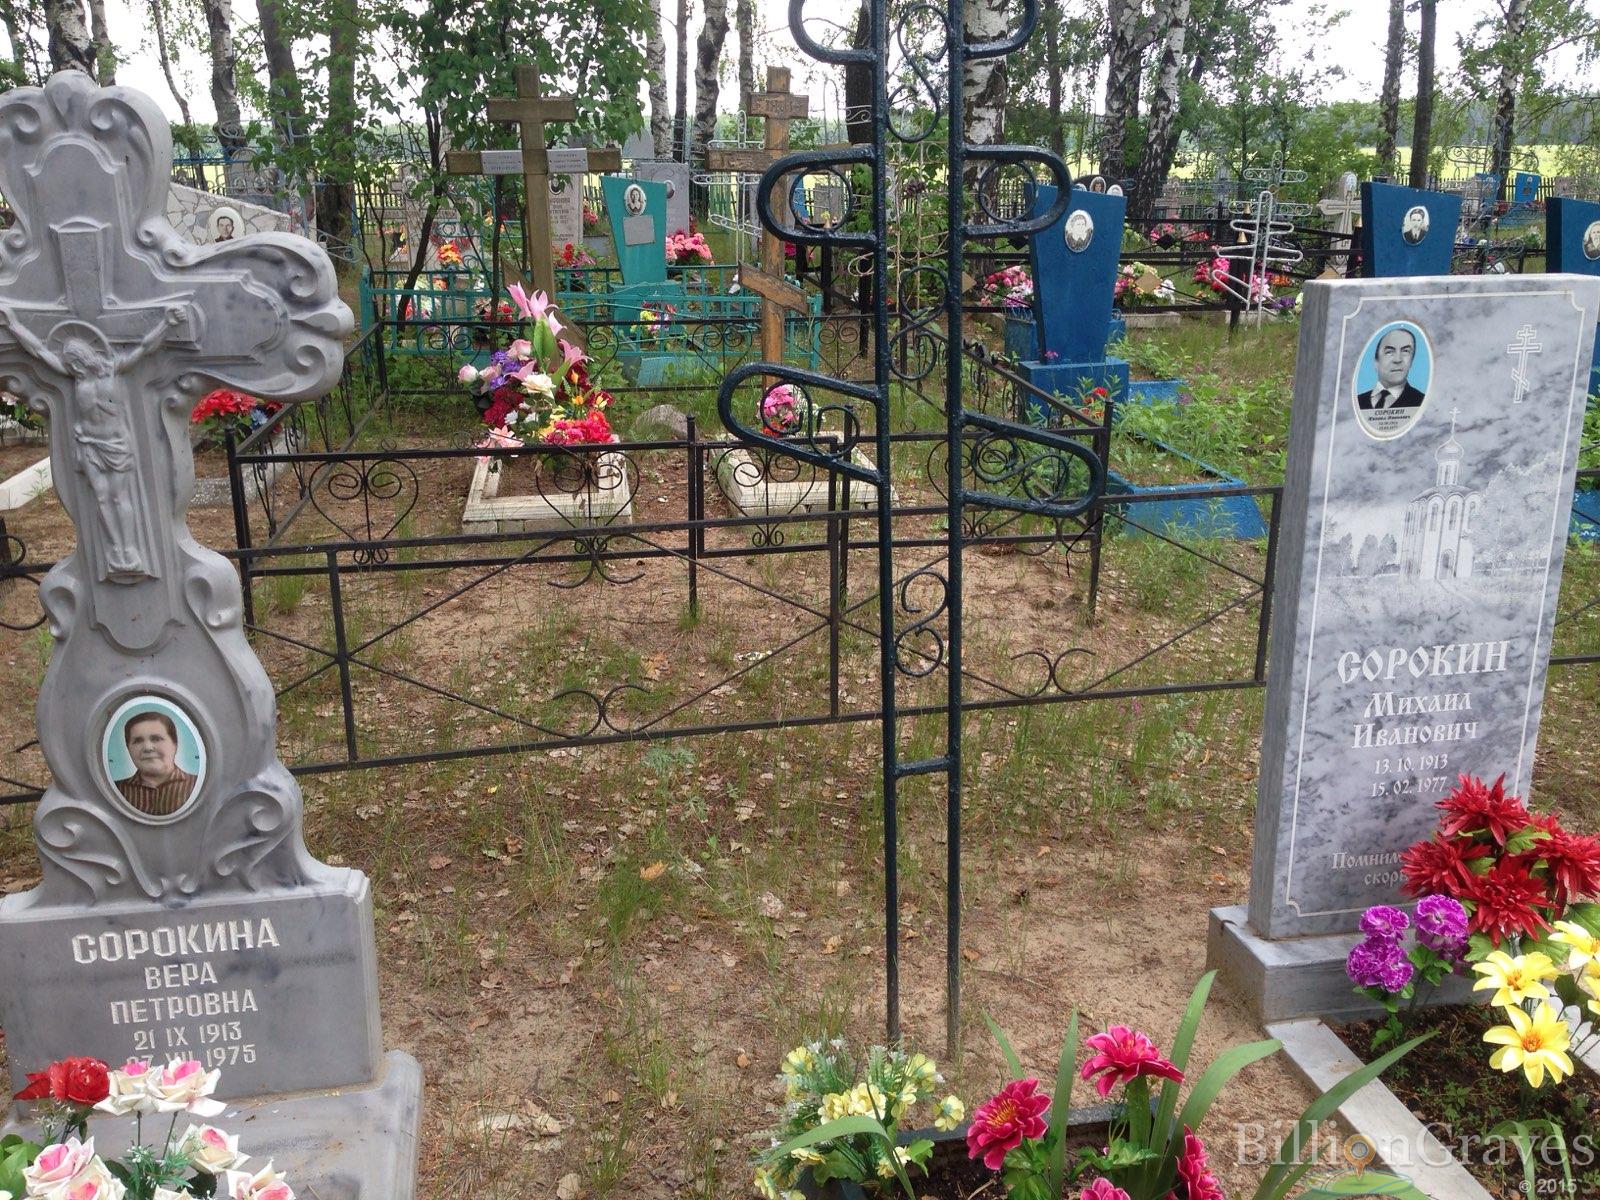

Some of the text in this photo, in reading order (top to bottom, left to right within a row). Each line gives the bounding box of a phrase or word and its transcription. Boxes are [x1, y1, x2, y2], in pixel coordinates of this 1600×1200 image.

[1337, 640, 1511, 684] СОРОКИН
[1363, 691, 1472, 718] Михаил
[1351, 721, 1479, 749] Иванович
[71, 917, 281, 964] СОРОКИНА
[144, 961, 218, 990] ВЕРА
[110, 988, 259, 1025] ПЕТРОВНА
[134, 1021, 242, 1051] 21 IX 1913
[206, 1044, 257, 1068] 1975
